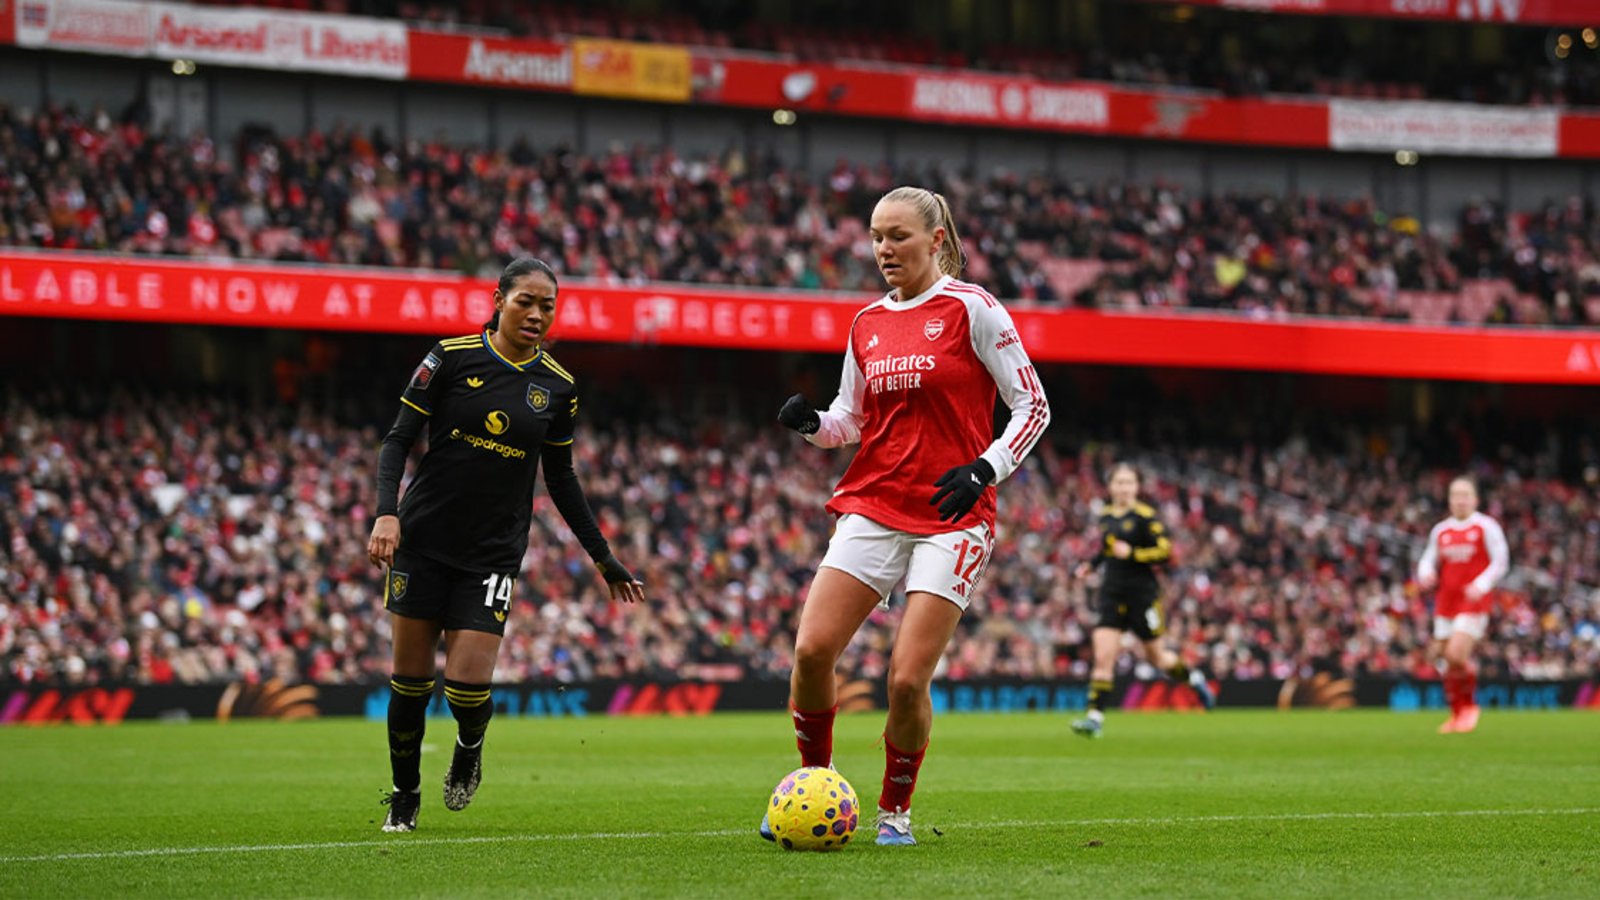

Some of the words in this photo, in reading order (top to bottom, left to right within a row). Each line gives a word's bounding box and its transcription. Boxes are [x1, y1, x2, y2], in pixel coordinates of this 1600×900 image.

[465, 39, 571, 86] Arsenal
[2, 266, 163, 309] LABLE
[190, 276, 299, 314] NOW
[323, 283, 375, 317] AT
[400, 287, 613, 331] ARSAL
[865, 354, 935, 380] Emirates
[871, 376, 883, 395] FLY
[886, 373, 921, 392] BETTER
[451, 428, 526, 460] Snapdragon
[953, 538, 984, 584] 12
[482, 573, 512, 610] 14
